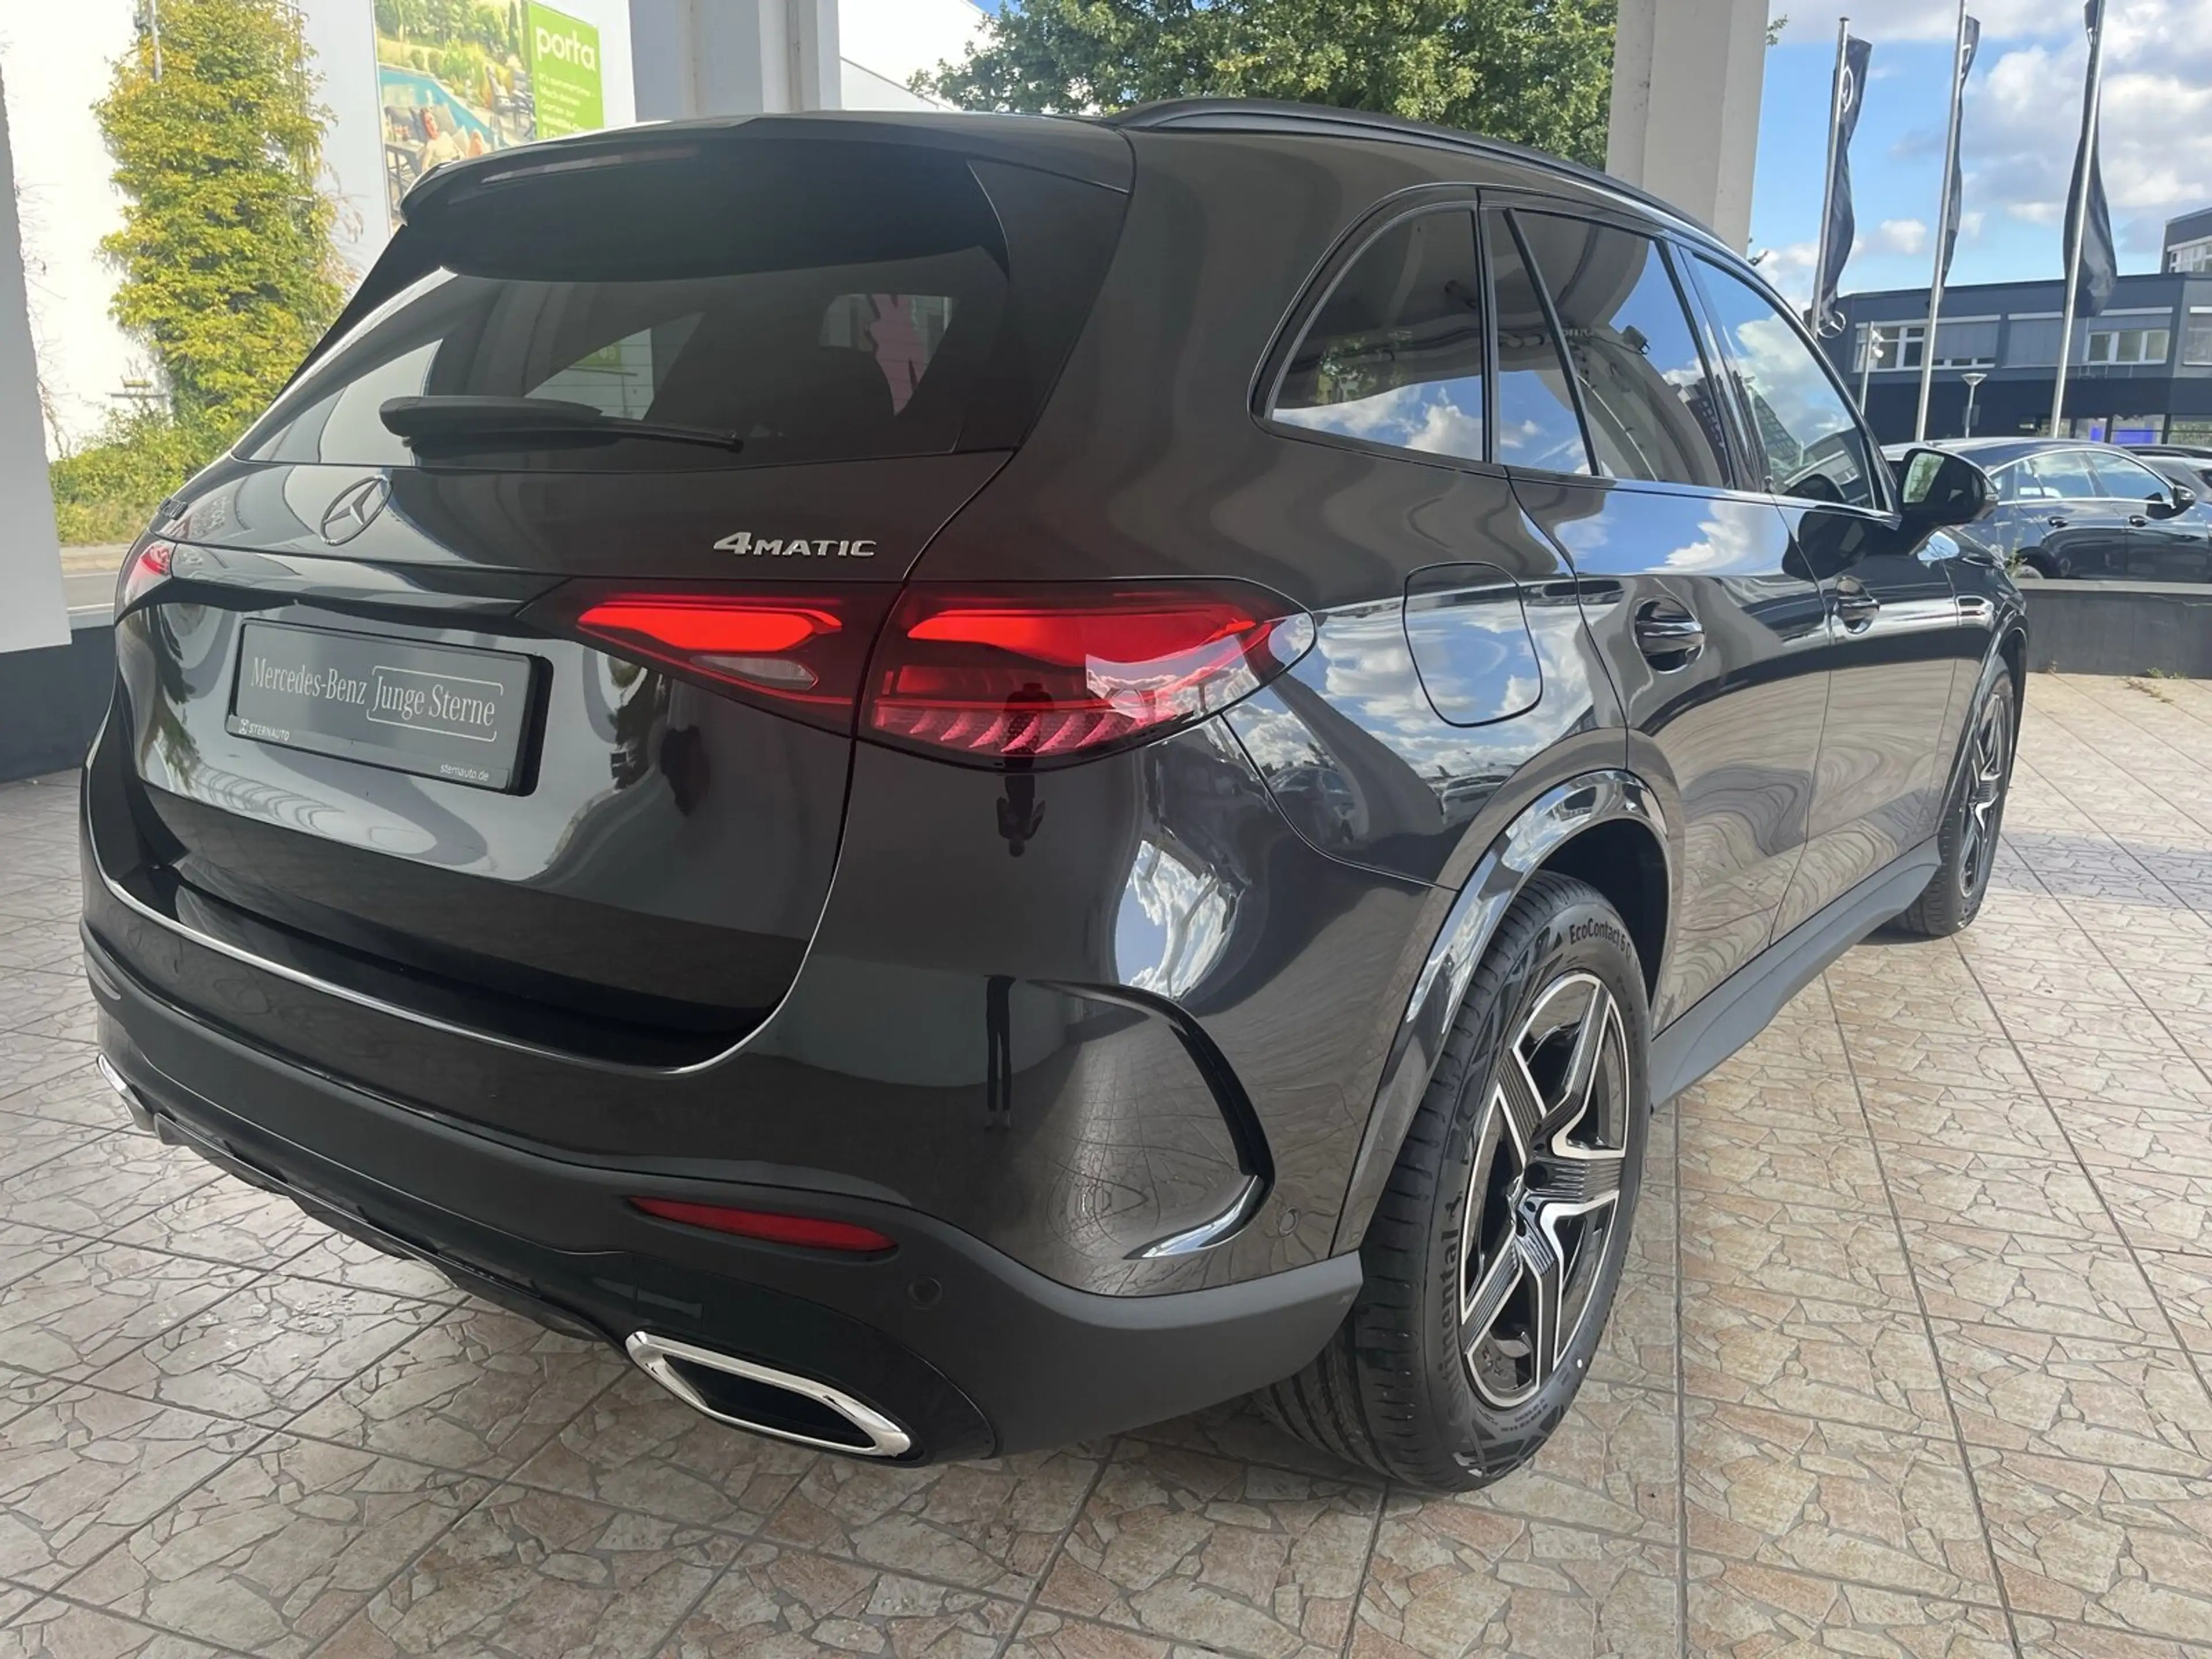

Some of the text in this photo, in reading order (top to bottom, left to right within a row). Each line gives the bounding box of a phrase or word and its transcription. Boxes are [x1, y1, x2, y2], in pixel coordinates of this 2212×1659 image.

[536, 26, 596, 71] porta
[713, 532, 876, 556] 4MATIC
[251, 657, 495, 726] Mercedes-Benz Junge Sterne
[249, 723, 290, 741] STERNAUTO
[440, 764, 488, 781] sternauto.de
[1569, 918, 1620, 948] EcoContact
